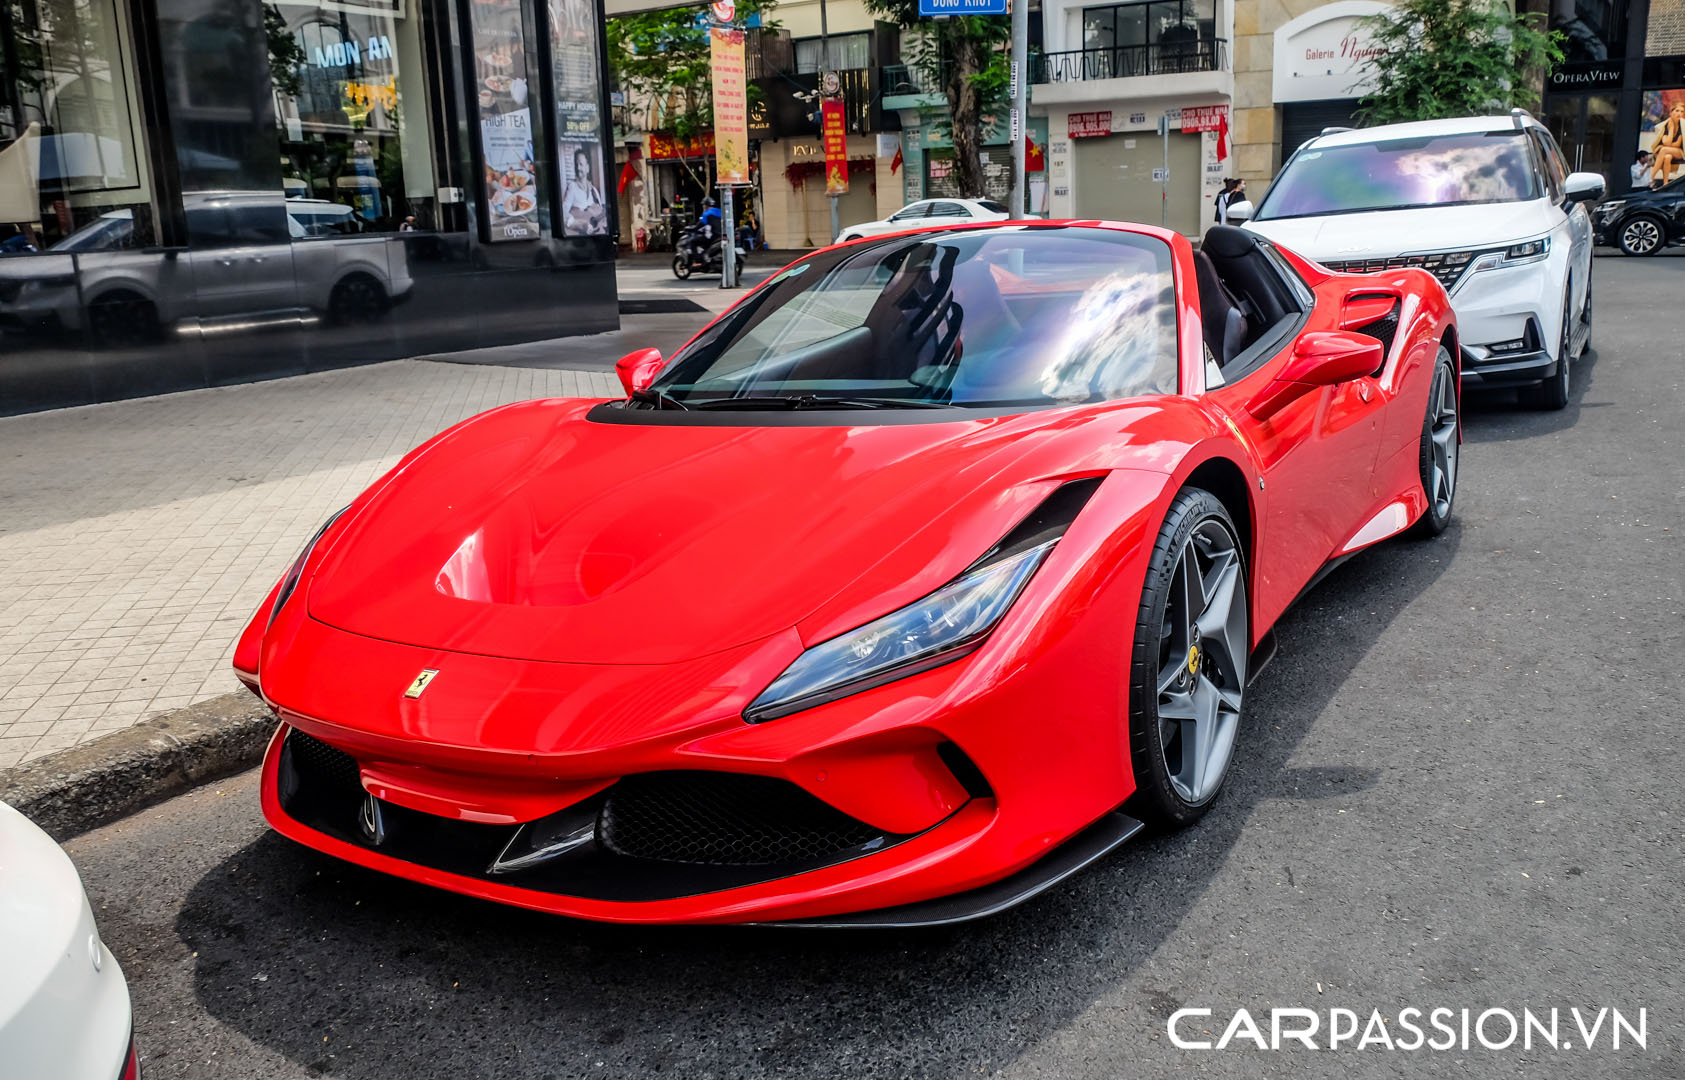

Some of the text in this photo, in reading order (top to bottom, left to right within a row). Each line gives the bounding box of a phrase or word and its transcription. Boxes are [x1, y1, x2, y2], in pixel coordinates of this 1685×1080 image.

[315, 41, 361, 69] MON
[1305, 48, 1335, 60] Galerie
[485, 114, 526, 128] HIGH TEA
[1173, 503, 1201, 543] MICHELIN
